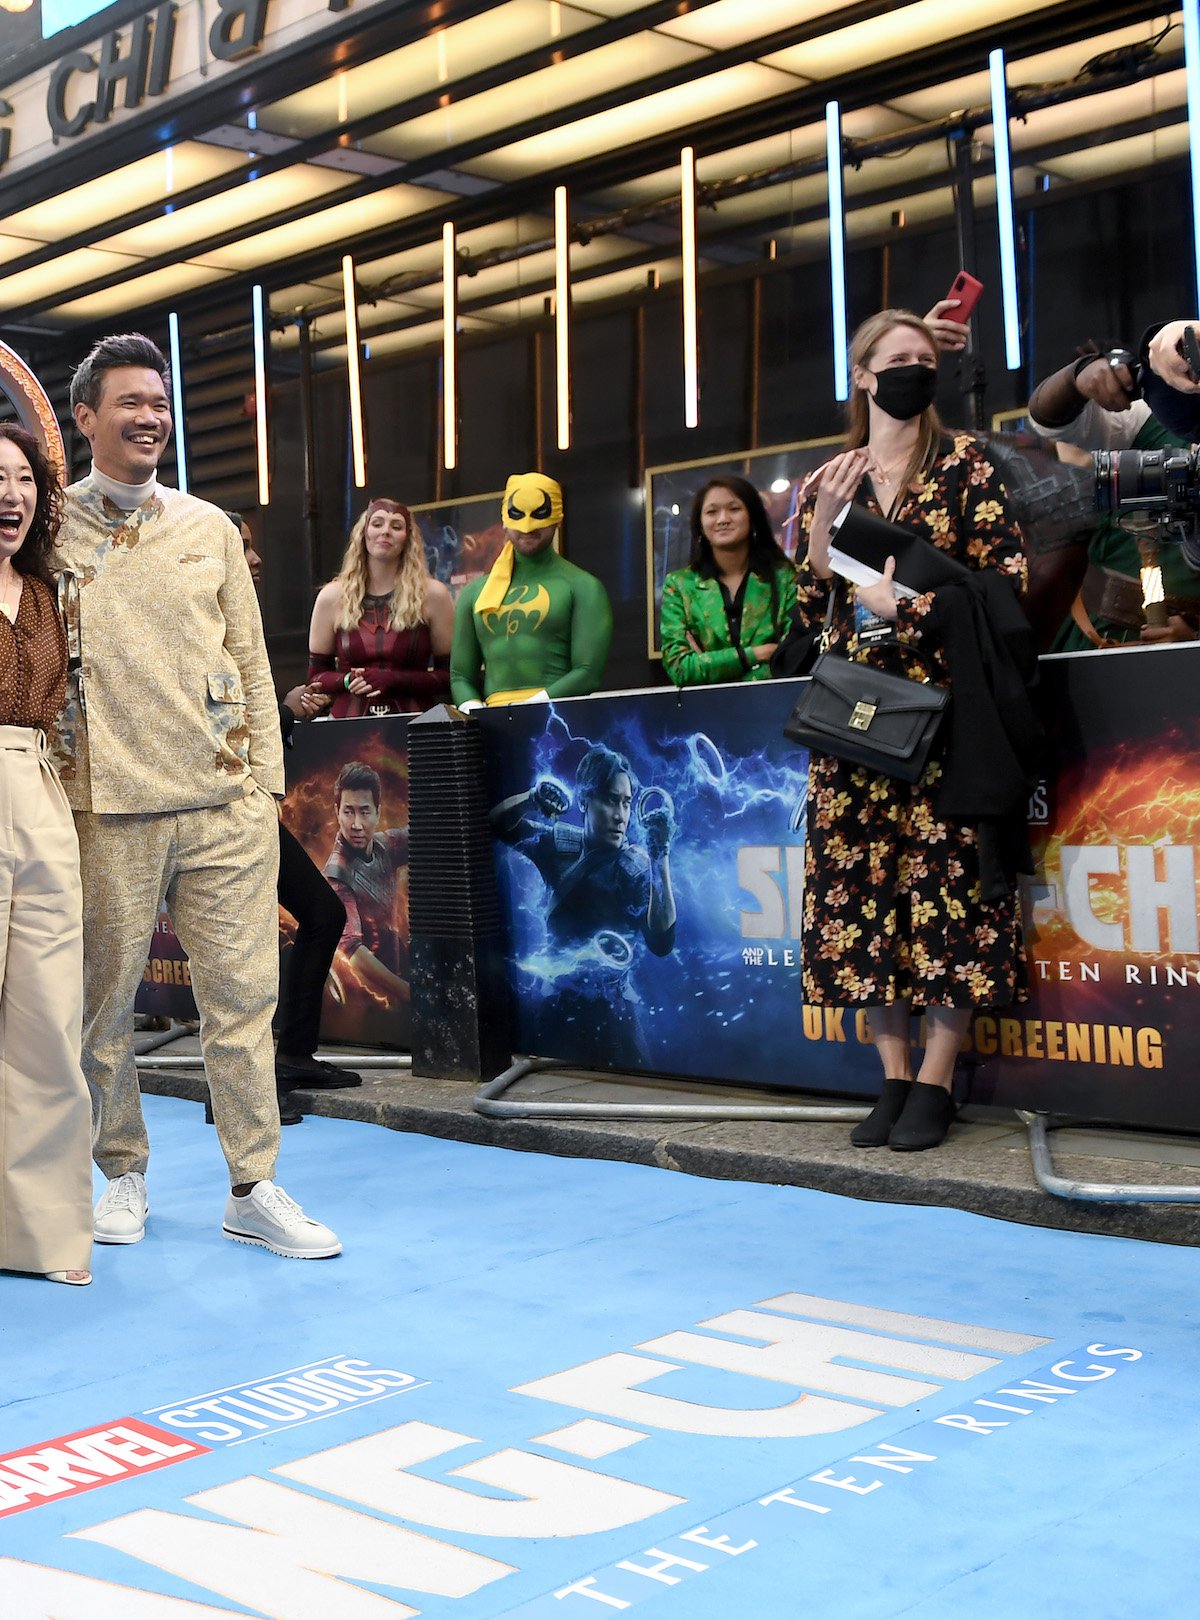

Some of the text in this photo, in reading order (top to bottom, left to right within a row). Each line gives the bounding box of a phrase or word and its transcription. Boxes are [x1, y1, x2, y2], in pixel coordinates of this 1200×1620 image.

[47, 3, 178, 138] CHI
[742, 947, 764, 956] AND
[743, 956, 764, 966] THE
[1033, 960, 1200, 988] TEN RIN
[802, 1004, 847, 1043] UK
[157, 1358, 416, 1442] STUDIOS
[553, 1342, 1145, 1610] THE TEN RINGS
